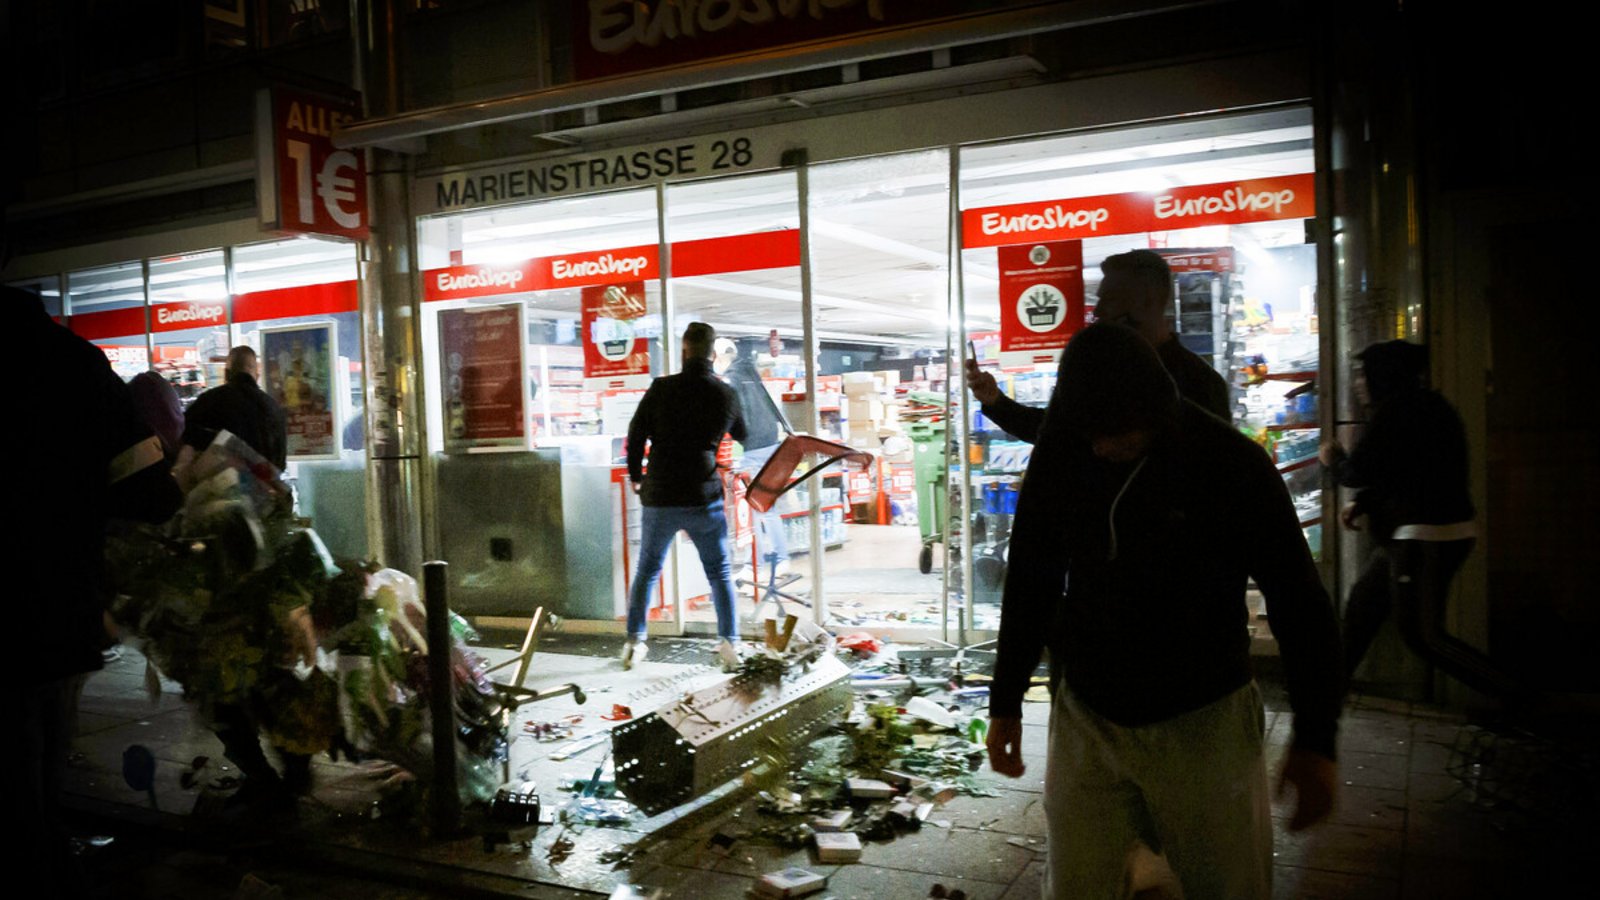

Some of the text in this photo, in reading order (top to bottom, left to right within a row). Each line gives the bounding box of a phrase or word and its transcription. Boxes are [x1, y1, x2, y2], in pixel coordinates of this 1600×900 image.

[589, 0, 884, 53] Euro
[287, 139, 361, 229] 1€
[436, 137, 753, 208] MARIENSTRASSE 28
[1153, 187, 1295, 220] EuroShop
[981, 205, 1109, 235] EuroShop
[437, 268, 524, 292] EuroShop
[551, 253, 648, 280] EuroShop
[157, 304, 224, 325] EuroShop
